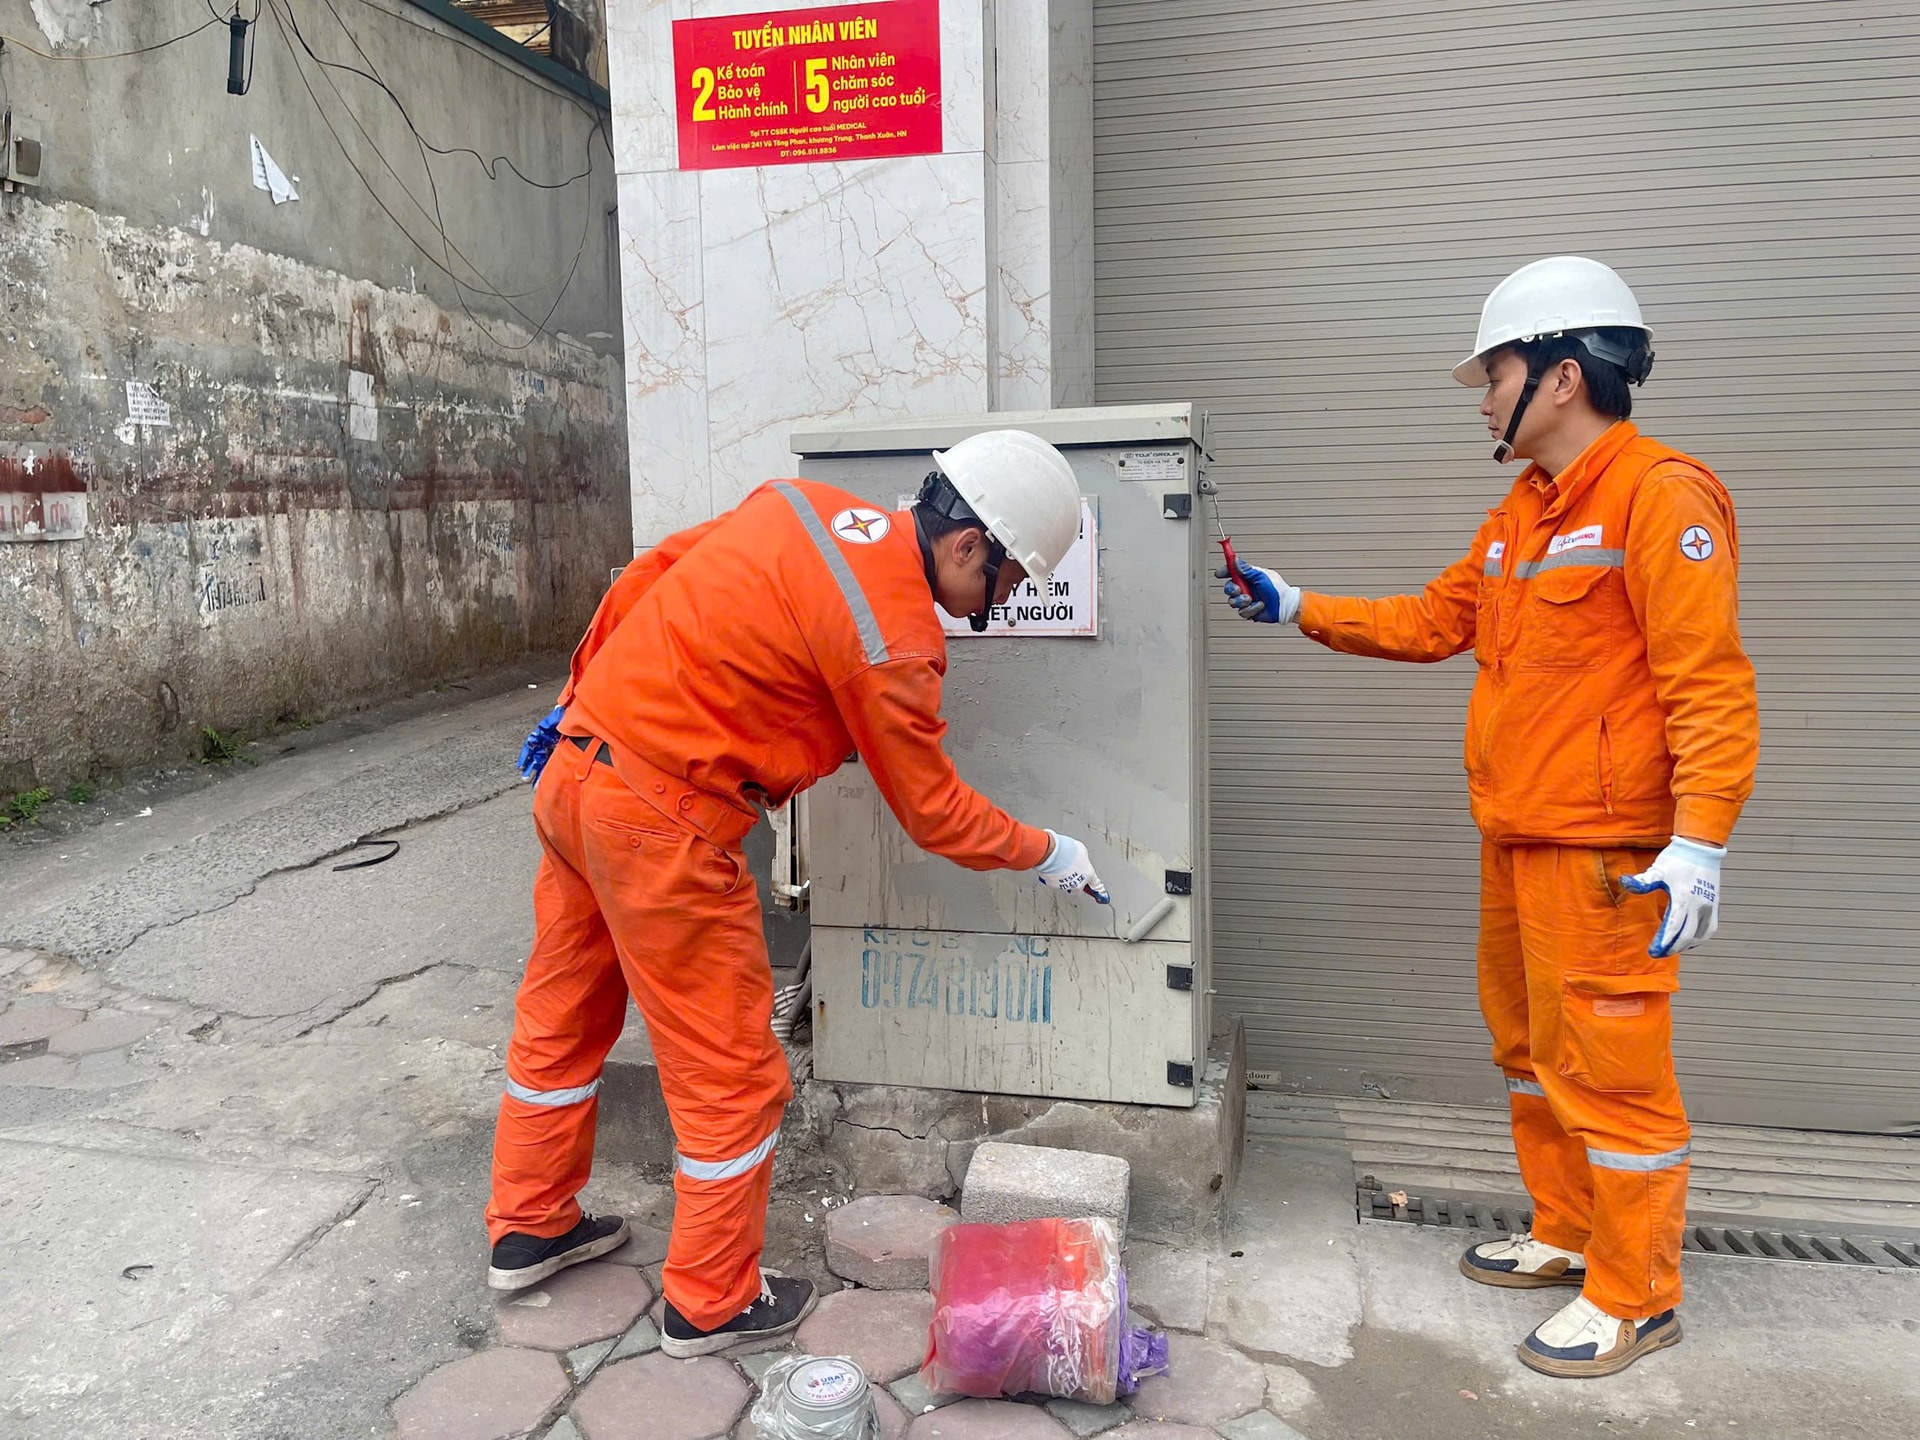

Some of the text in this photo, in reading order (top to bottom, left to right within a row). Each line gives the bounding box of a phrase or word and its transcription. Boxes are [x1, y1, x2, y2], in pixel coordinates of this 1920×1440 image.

[732, 15, 877, 50] TUYỂN NHÂN VIÊN
[717, 62, 766, 80] Kế toán
[831, 51, 895, 71] Nhân viên
[717, 82, 761, 101] Bảo vệ
[805, 57, 830, 114] 5
[832, 72, 895, 91] chăm sóc
[691, 67, 716, 122] 2
[833, 86, 925, 114] người cao tuổi
[718, 100, 788, 120] Hành chính
[836, 122, 867, 131] MEDICAL
[856, 132, 876, 140] Thanh
[1017, 601, 1073, 621] NGƯỜI
[1245, 1071, 1272, 1080] door
